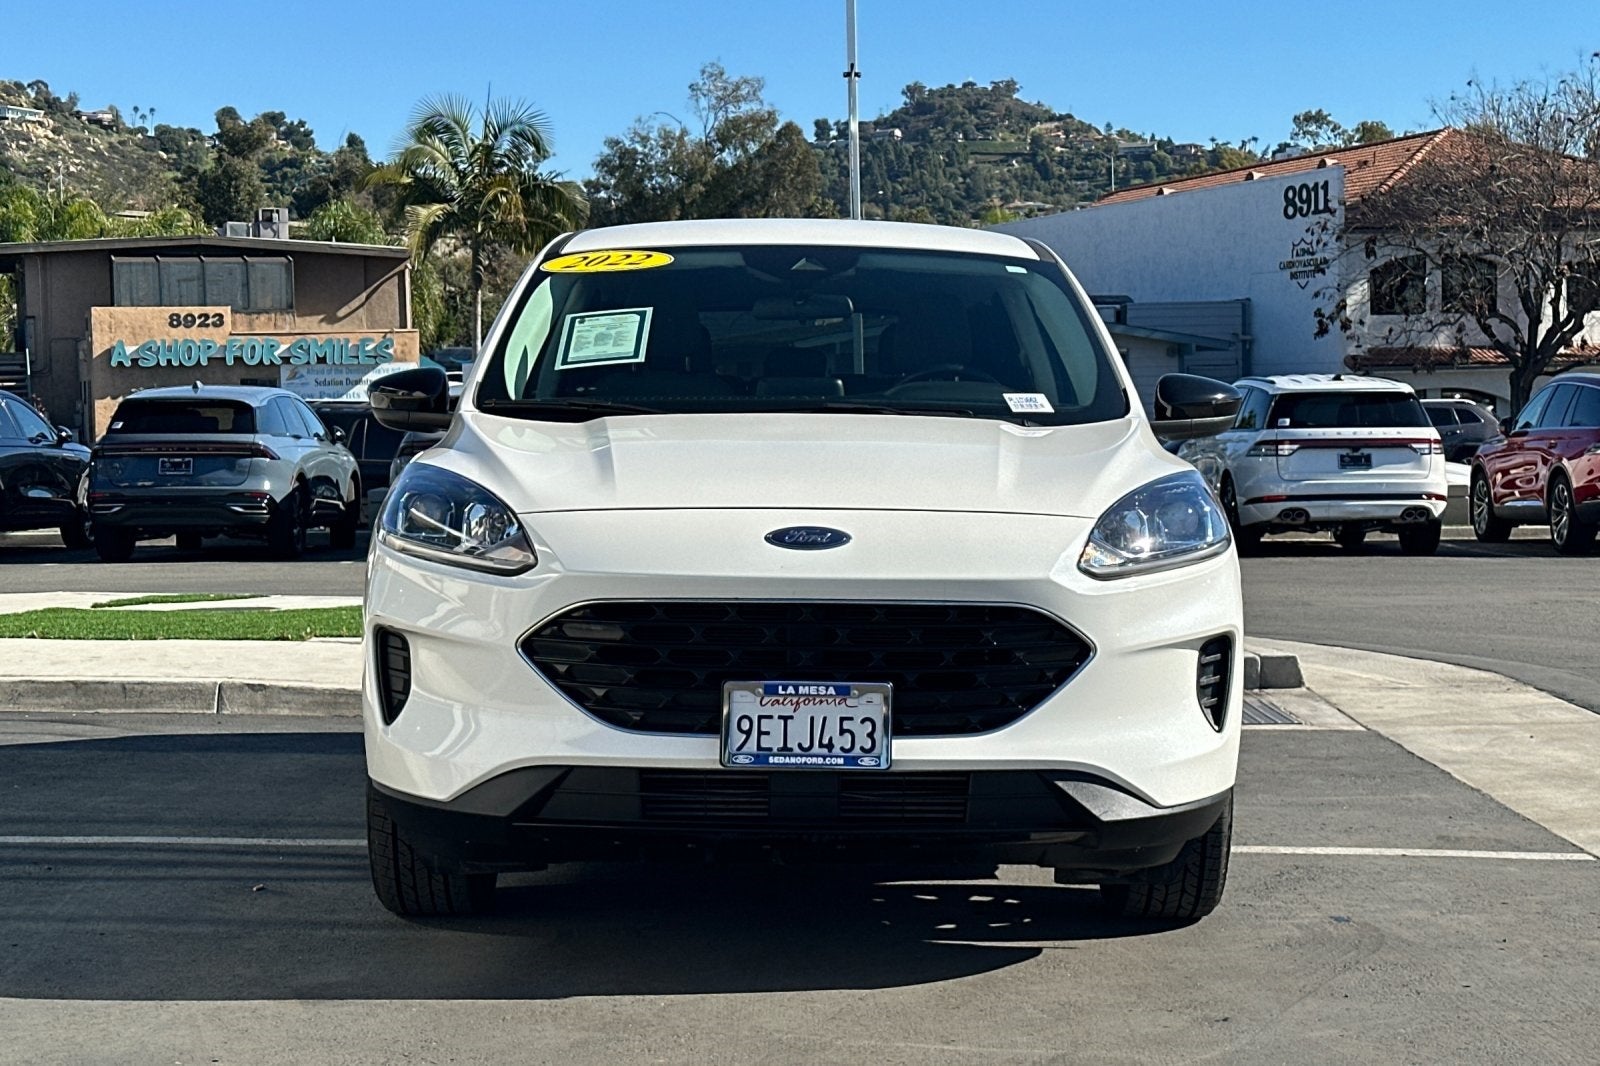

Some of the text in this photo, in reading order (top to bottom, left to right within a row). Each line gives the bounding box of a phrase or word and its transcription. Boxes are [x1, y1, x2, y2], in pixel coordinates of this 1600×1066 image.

[1283, 180, 1330, 219] 8911
[560, 254, 653, 269] 2022
[1290, 269, 1316, 280] INSTITUTE
[167, 312, 225, 328] 8923
[110, 337, 395, 367] A SHOP FOR SMILES
[314, 377, 343, 386] Sedation
[784, 529, 832, 543] Ford
[778, 685, 836, 695] LA MESA
[760, 695, 858, 712] California
[735, 714, 877, 754] 9EIJ453
[768, 756, 844, 765] SEDANOFORD.COM
